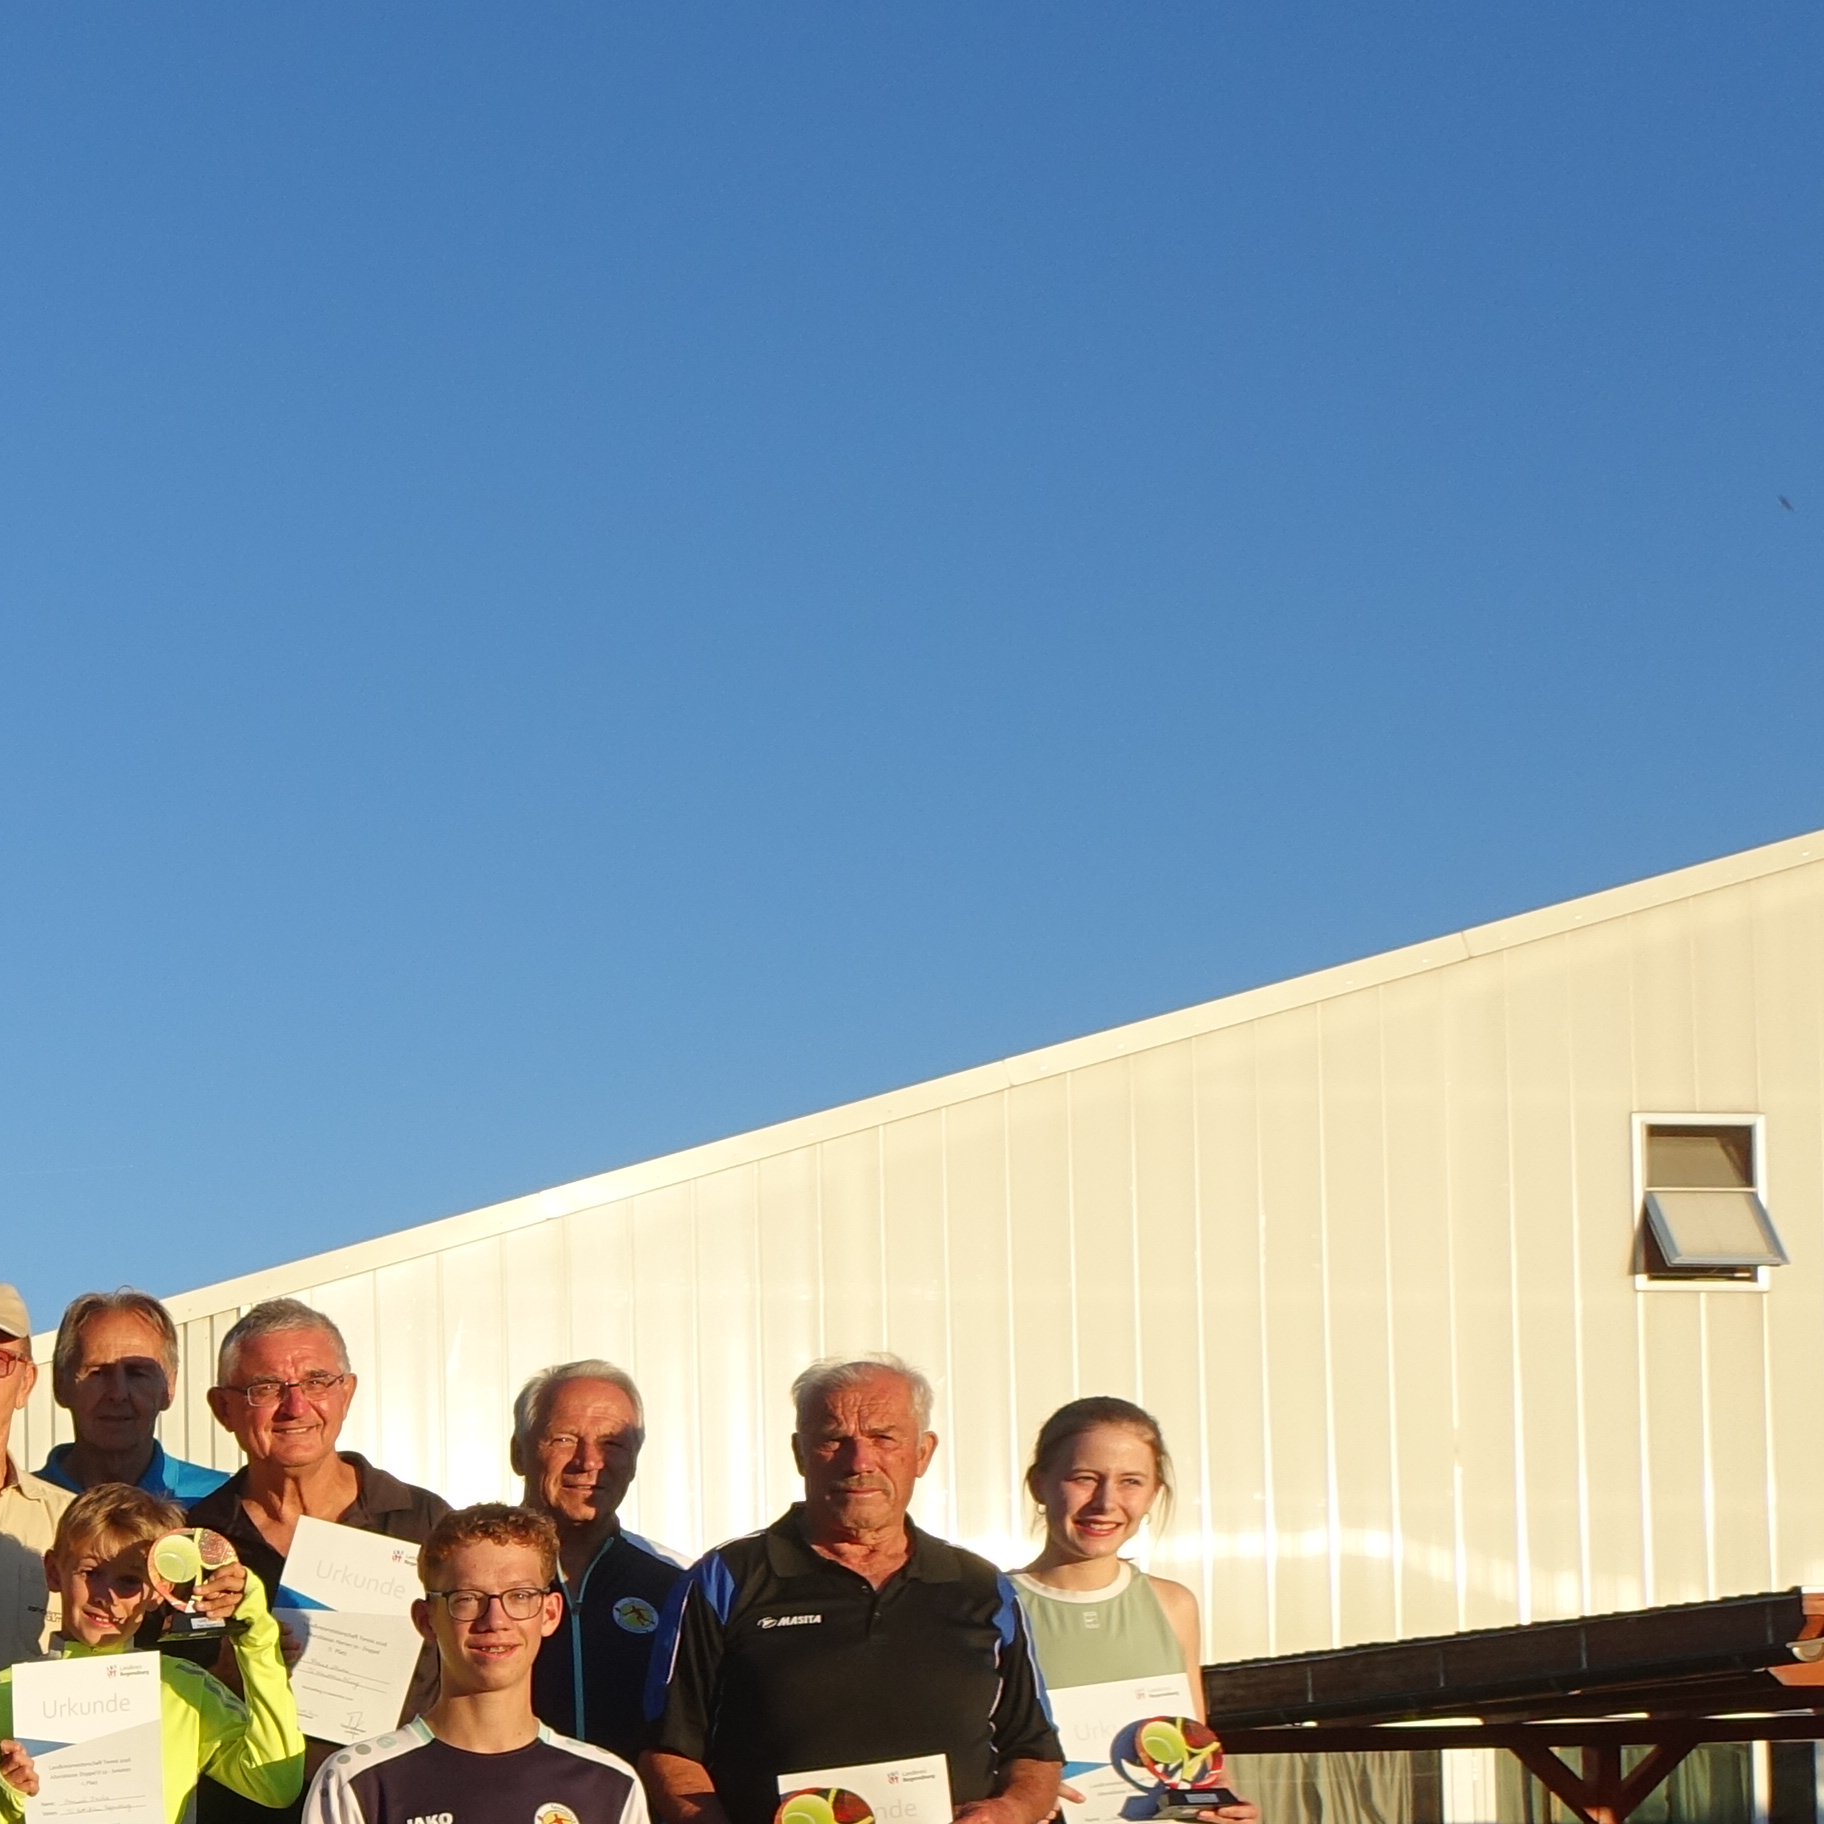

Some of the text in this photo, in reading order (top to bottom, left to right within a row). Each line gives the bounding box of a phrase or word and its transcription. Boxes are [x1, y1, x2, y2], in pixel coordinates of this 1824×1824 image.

[315, 1560, 406, 1600] Urkunde
[776, 1614, 822, 1627] MASITA
[119, 1670, 150, 1678] Regensburg
[42, 1693, 131, 1719] Urkunde
